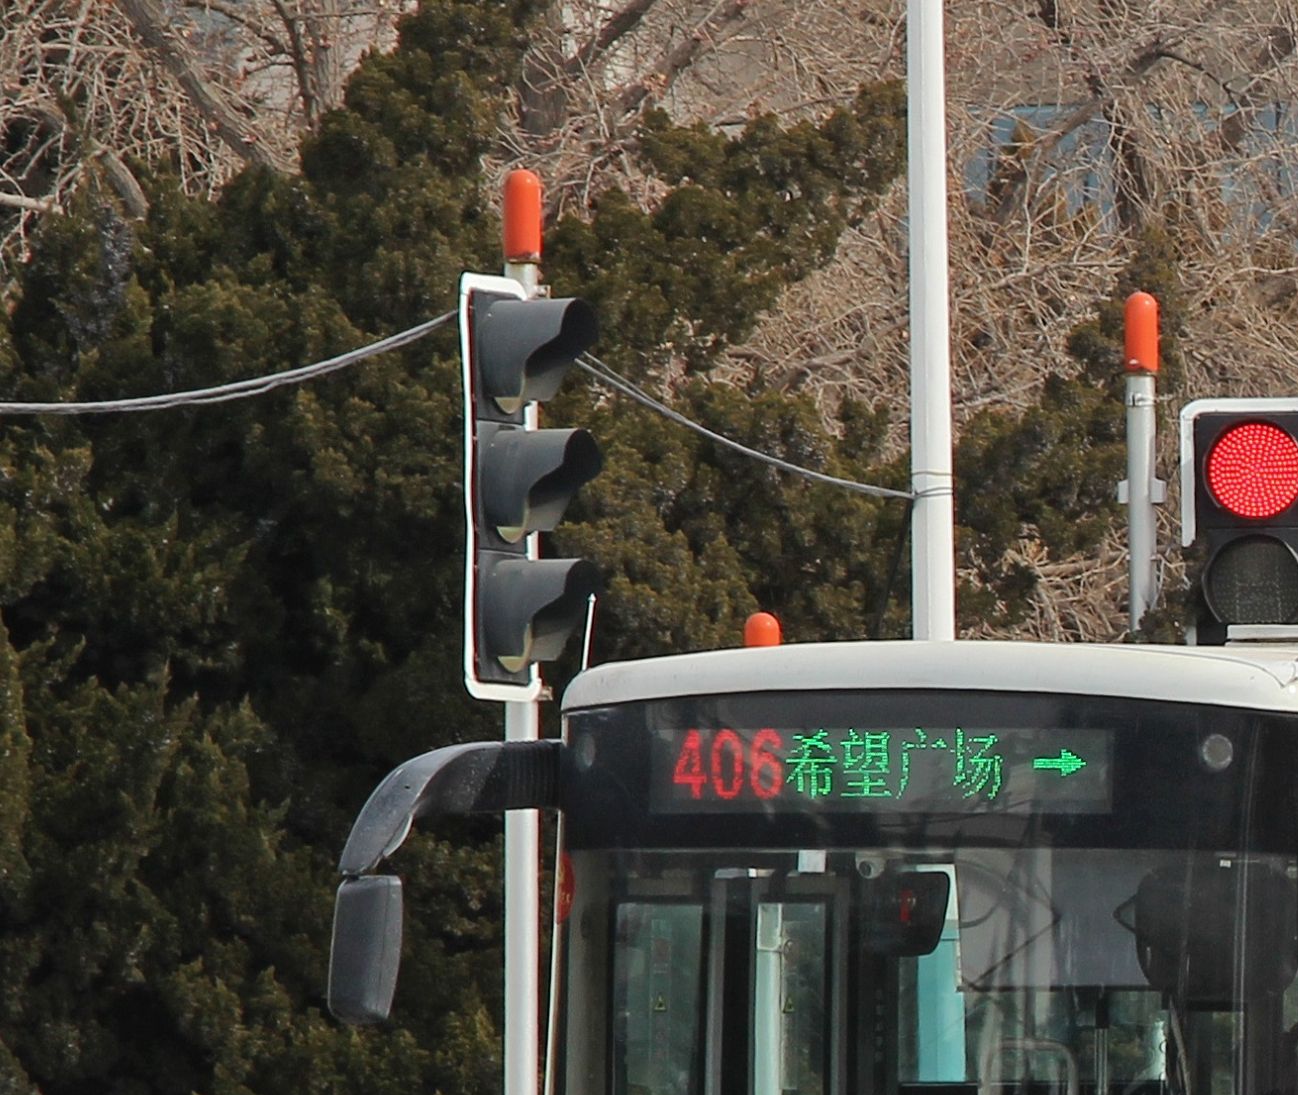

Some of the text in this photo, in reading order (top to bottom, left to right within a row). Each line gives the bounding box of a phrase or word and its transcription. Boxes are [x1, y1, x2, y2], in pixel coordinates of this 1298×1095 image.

[673, 727, 1002, 799] 406 希望广场
